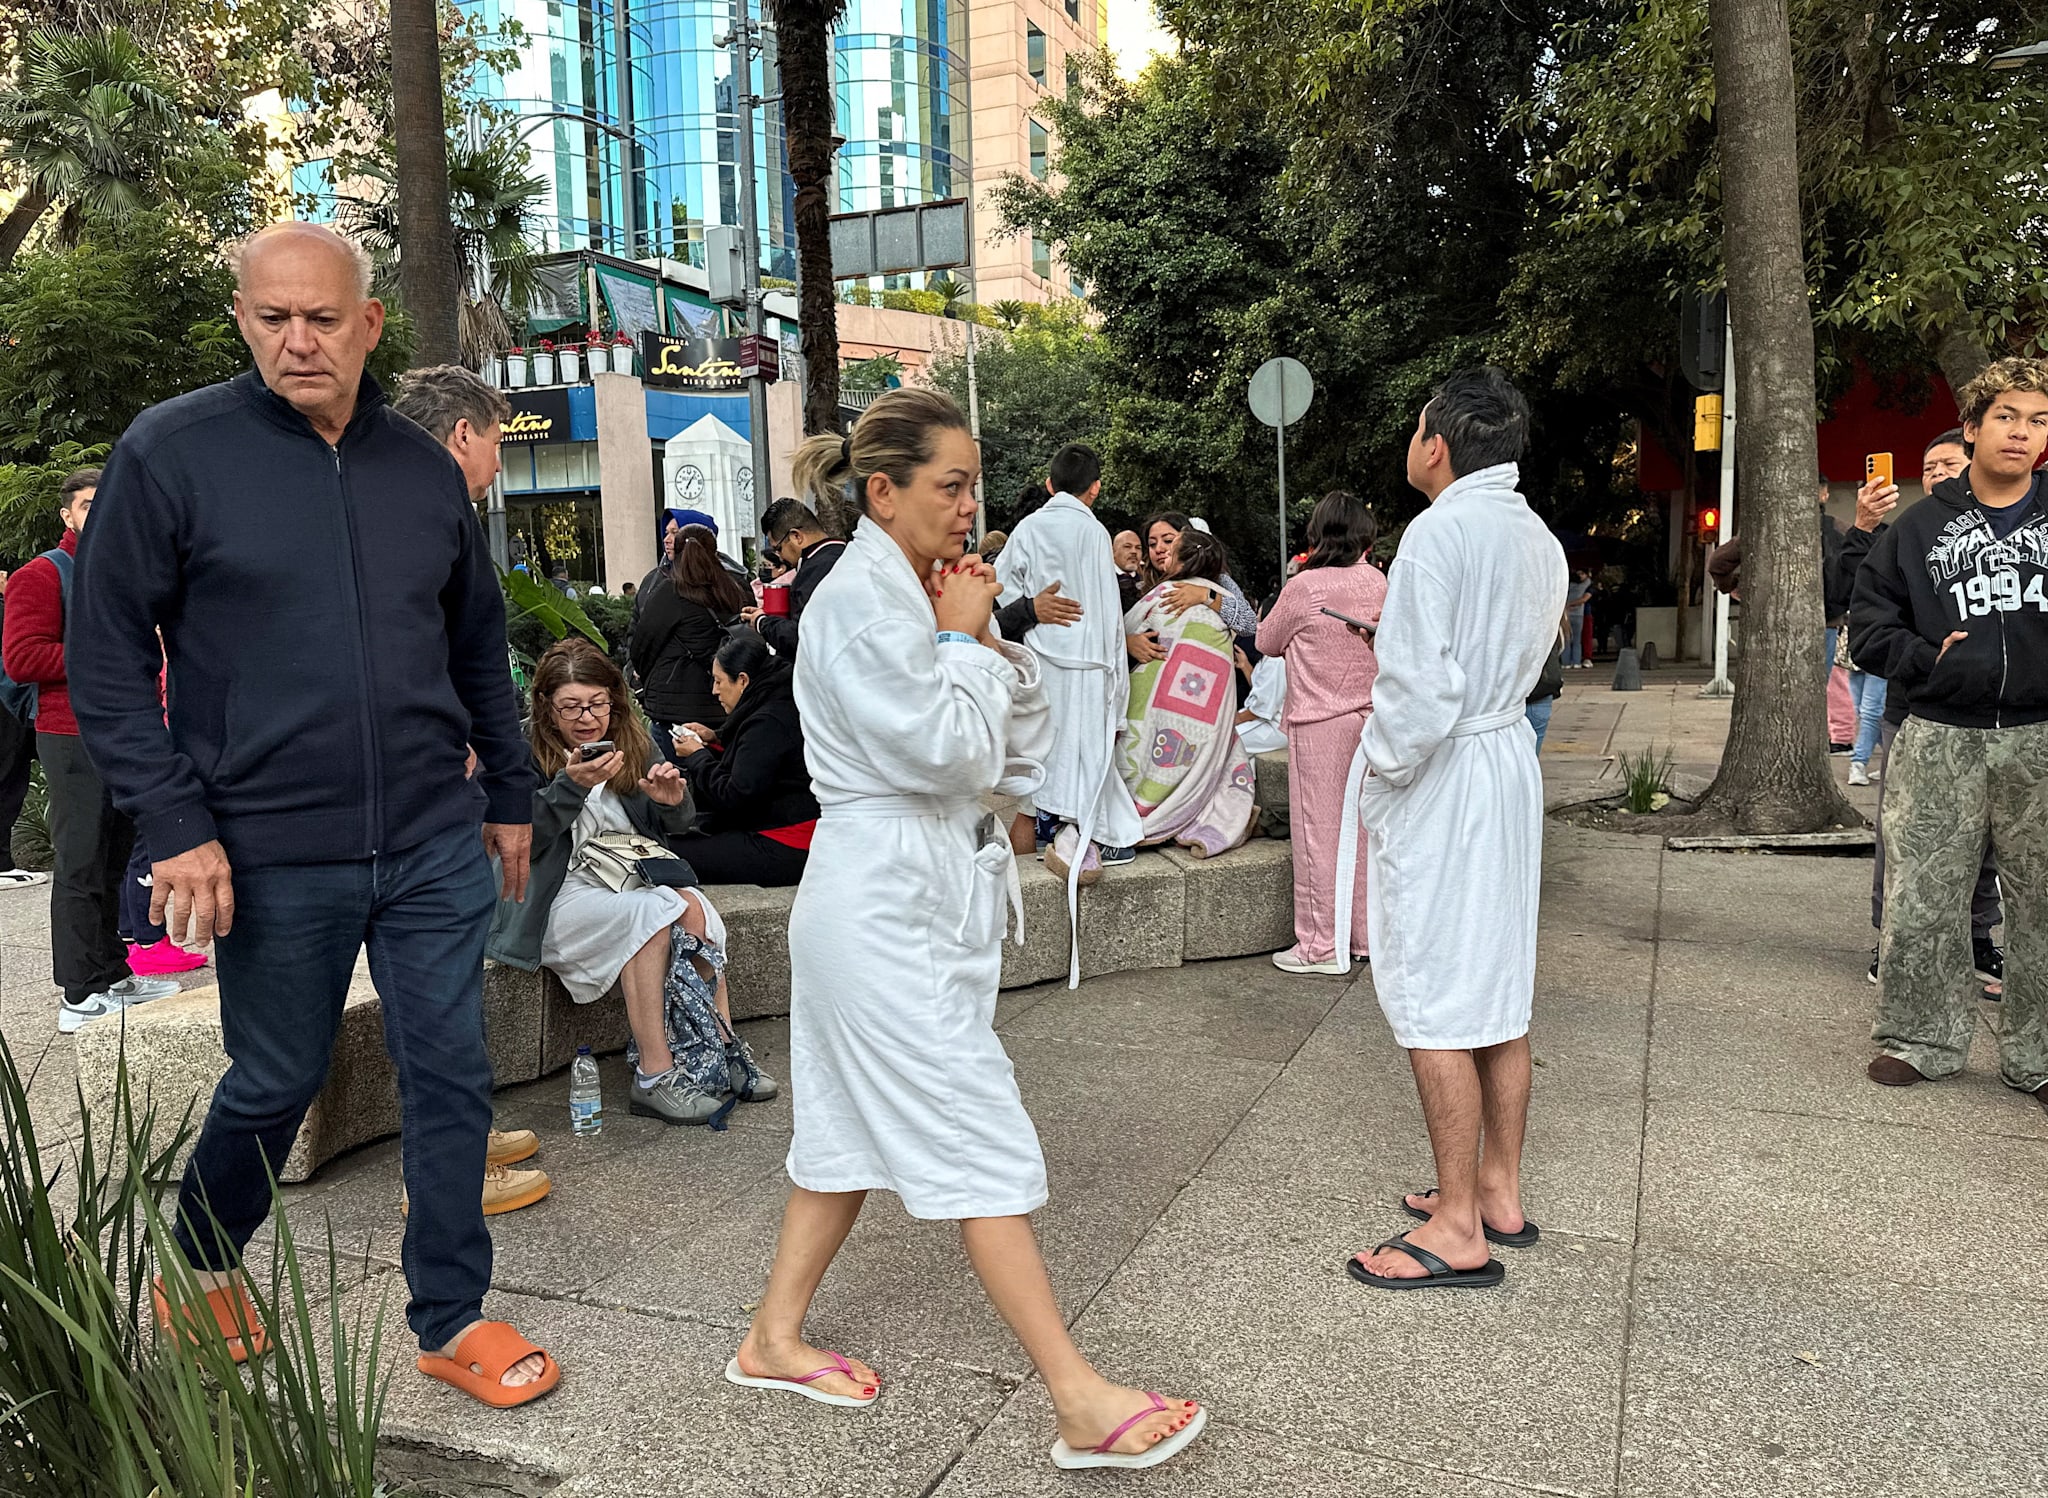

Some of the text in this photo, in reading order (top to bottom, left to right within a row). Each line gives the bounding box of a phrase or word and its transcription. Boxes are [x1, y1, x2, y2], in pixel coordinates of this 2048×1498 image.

[658, 335, 690, 347] TERRAZA
[682, 378, 742, 386] RISTORANTE
[1948, 573, 2048, 622] 1994
